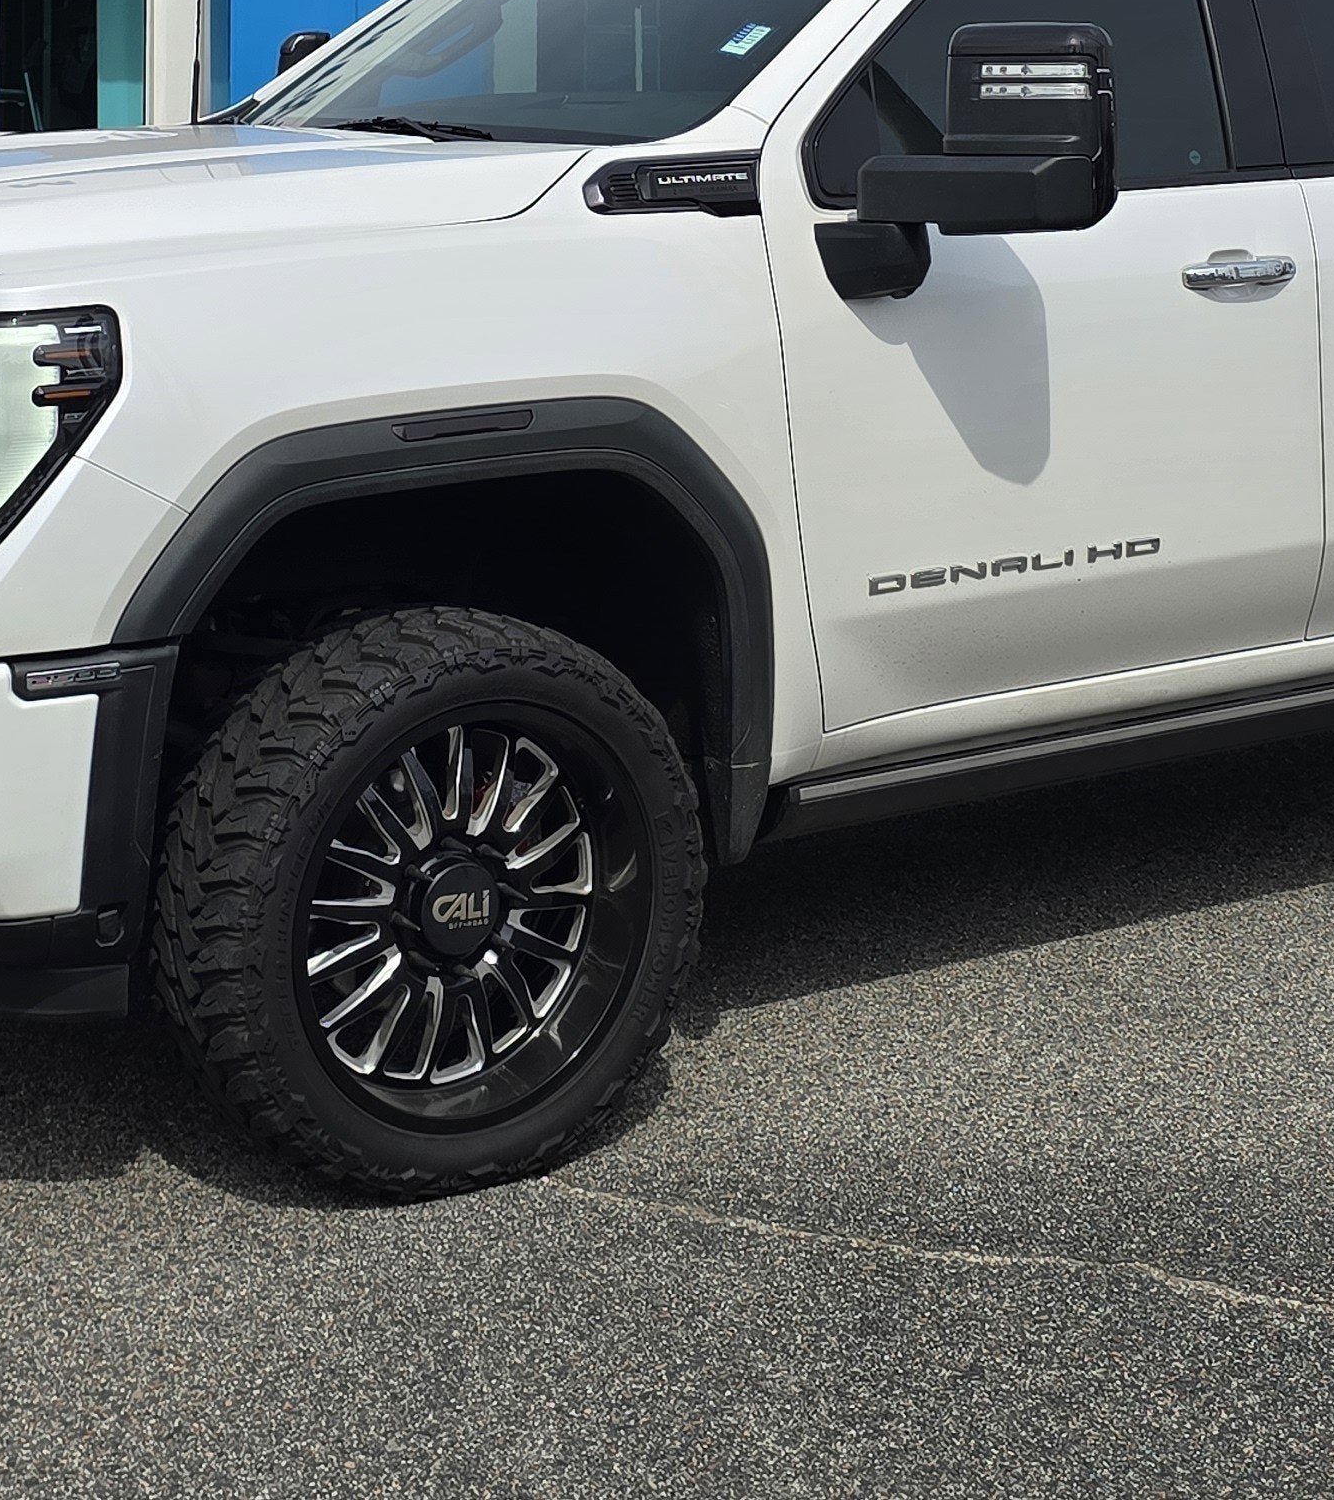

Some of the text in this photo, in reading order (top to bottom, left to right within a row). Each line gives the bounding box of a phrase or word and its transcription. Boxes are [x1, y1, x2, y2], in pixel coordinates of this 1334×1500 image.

[657, 171, 749, 185] ULTIMATE
[868, 536, 1161, 597] DENALI HD
